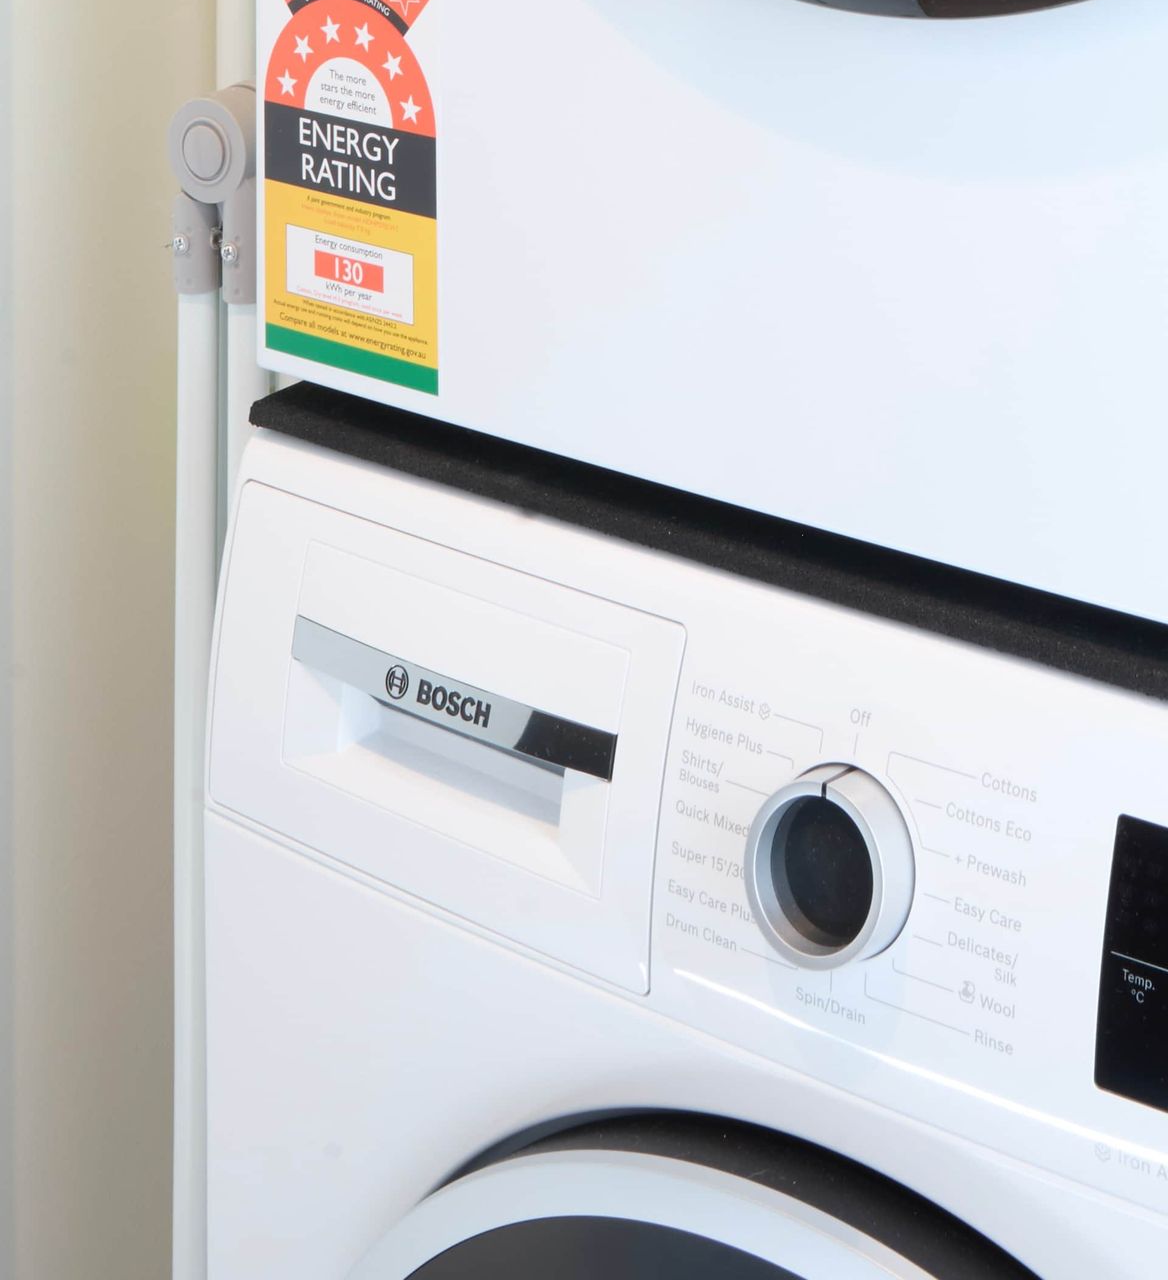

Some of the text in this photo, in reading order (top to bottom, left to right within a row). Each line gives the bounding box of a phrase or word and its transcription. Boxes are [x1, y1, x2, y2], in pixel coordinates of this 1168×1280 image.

[329, 69, 367, 86] The more
[319, 96, 377, 115] energy efficient
[320, 83, 376, 101] stars the more
[298, 117, 399, 165] ENERGY
[301, 153, 397, 201] RATING
[315, 234, 383, 260] Energy consumption
[335, 257, 363, 284] 130
[325, 281, 373, 301] kWh per year
[279, 312, 308, 326] Compare
[317, 323, 339, 336] models
[416, 679, 492, 728] BOSCH
[691, 680, 755, 715] Iron Assist
[849, 707, 872, 727] Off
[685, 716, 763, 755] Hygiene Plus
[681, 750, 724, 777] Shirts/
[679, 768, 720, 794] Blouses
[981, 772, 1038, 804] Cottons
[675, 800, 710, 824] Quick
[945, 802, 1032, 842] Cottons Eco
[671, 842, 707, 870] Super
[966, 854, 1028, 888] Prewash
[667, 879, 695, 903] Easy
[699, 891, 727, 913] Care
[954, 897, 1023, 933] Easy Care
[666, 913, 738, 952] Drum Clean
[947, 931, 1019, 967] Delicates/
[994, 966, 1018, 987] Silk
[1122, 969, 1155, 991] Temp.
[795, 986, 866, 1025] Spin/Drain
[979, 994, 1016, 1020] Wool
[974, 1030, 1014, 1056] Rinse
[1117, 1149, 1152, 1176] Iron
